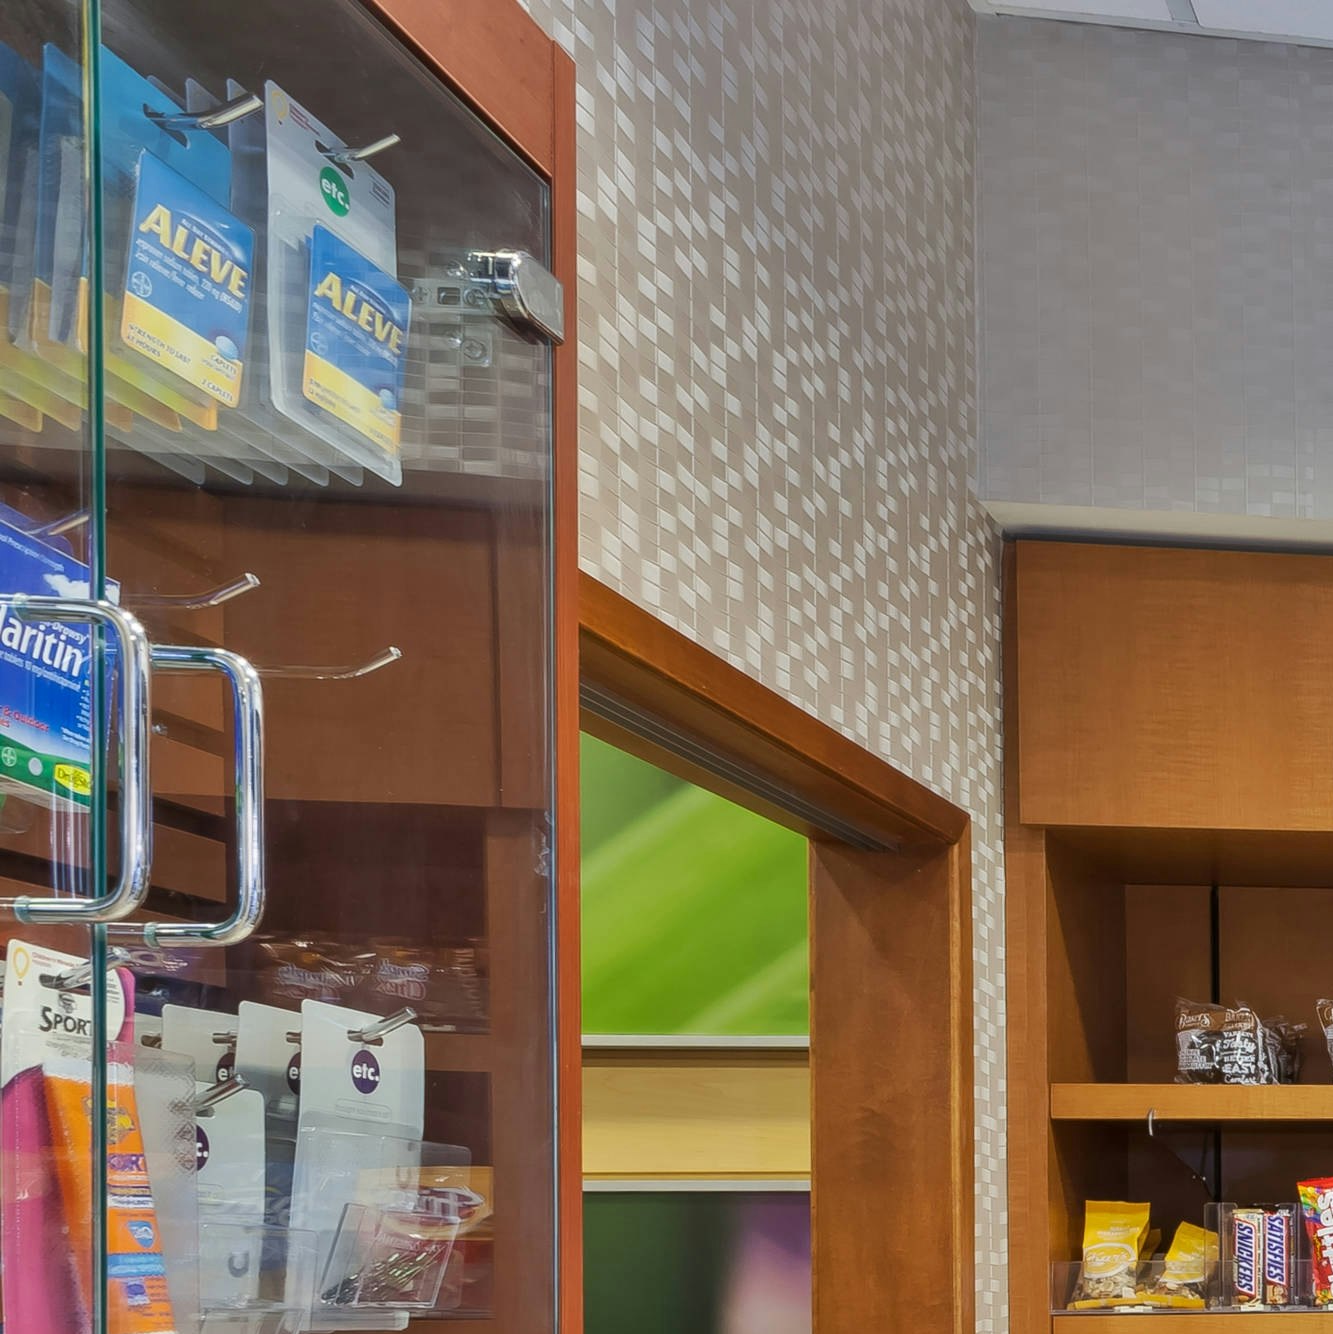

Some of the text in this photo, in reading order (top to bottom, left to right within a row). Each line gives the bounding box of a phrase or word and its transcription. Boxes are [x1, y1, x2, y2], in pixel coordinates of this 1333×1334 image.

[321, 174, 350, 210] etc.
[139, 204, 248, 298] ALEVE
[314, 272, 404, 354] ALEVE
[352, 1062, 380, 1082] etc.
[1237, 1222, 1254, 1296] SNICKERS
[1267, 1215, 1283, 1284] SATISFIES
